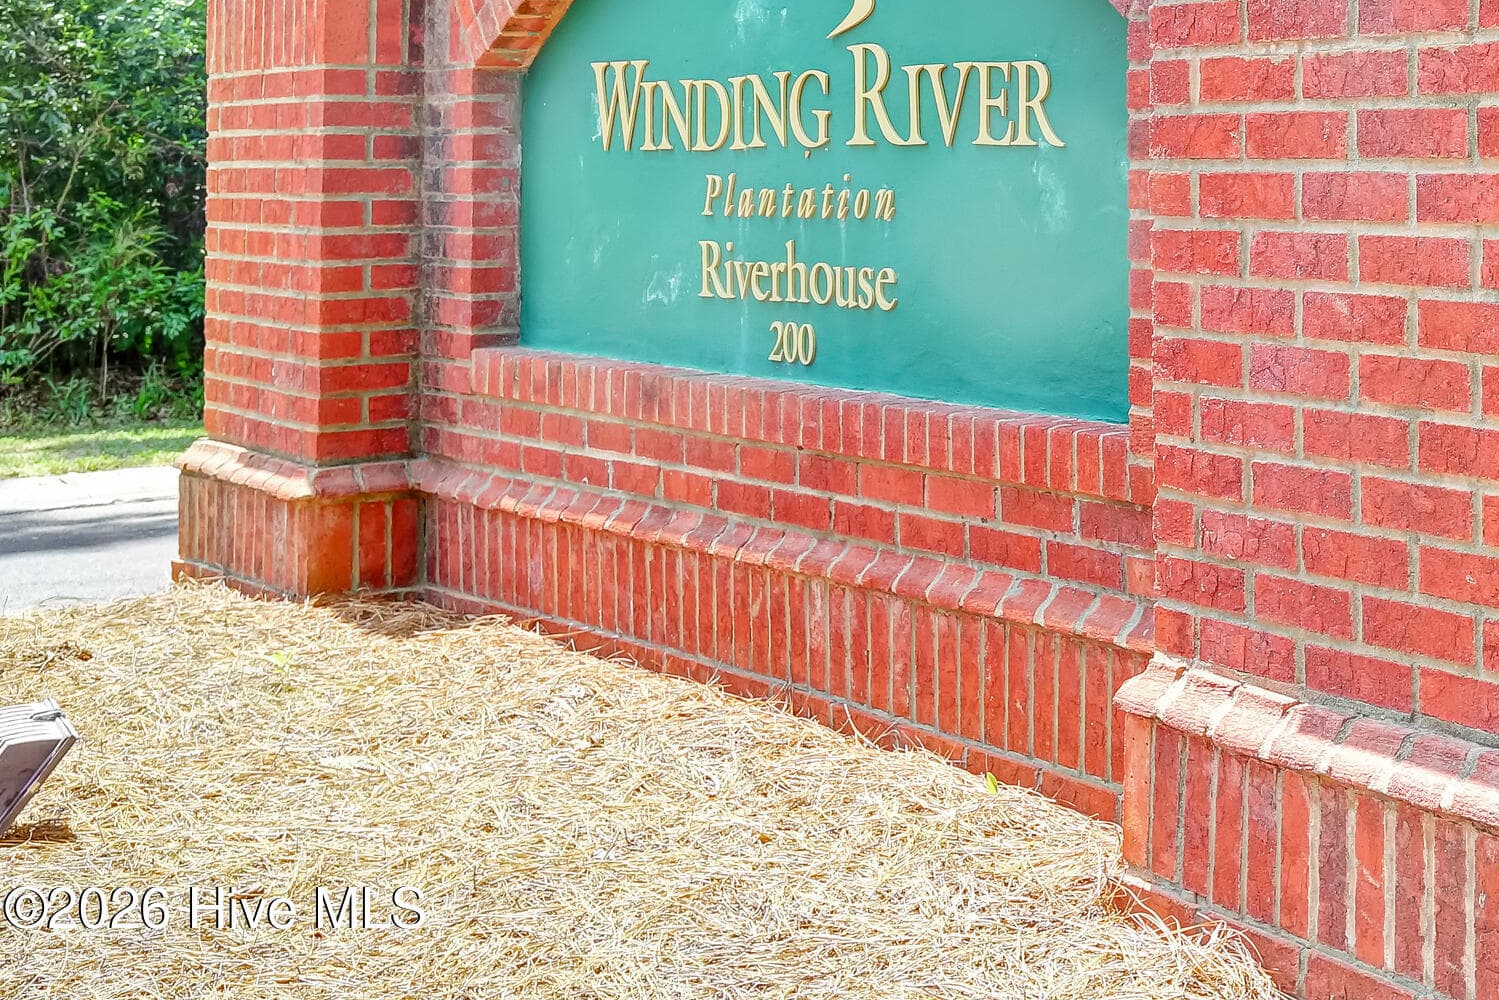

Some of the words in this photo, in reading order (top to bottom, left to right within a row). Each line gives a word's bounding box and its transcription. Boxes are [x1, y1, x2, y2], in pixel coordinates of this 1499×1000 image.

[591, 60, 832, 152] WINDING
[846, 43, 1065, 147] RIVER
[702, 173, 896, 221] Plantation
[698, 239, 898, 311] Riverhouse
[769, 320, 817, 366] 200
